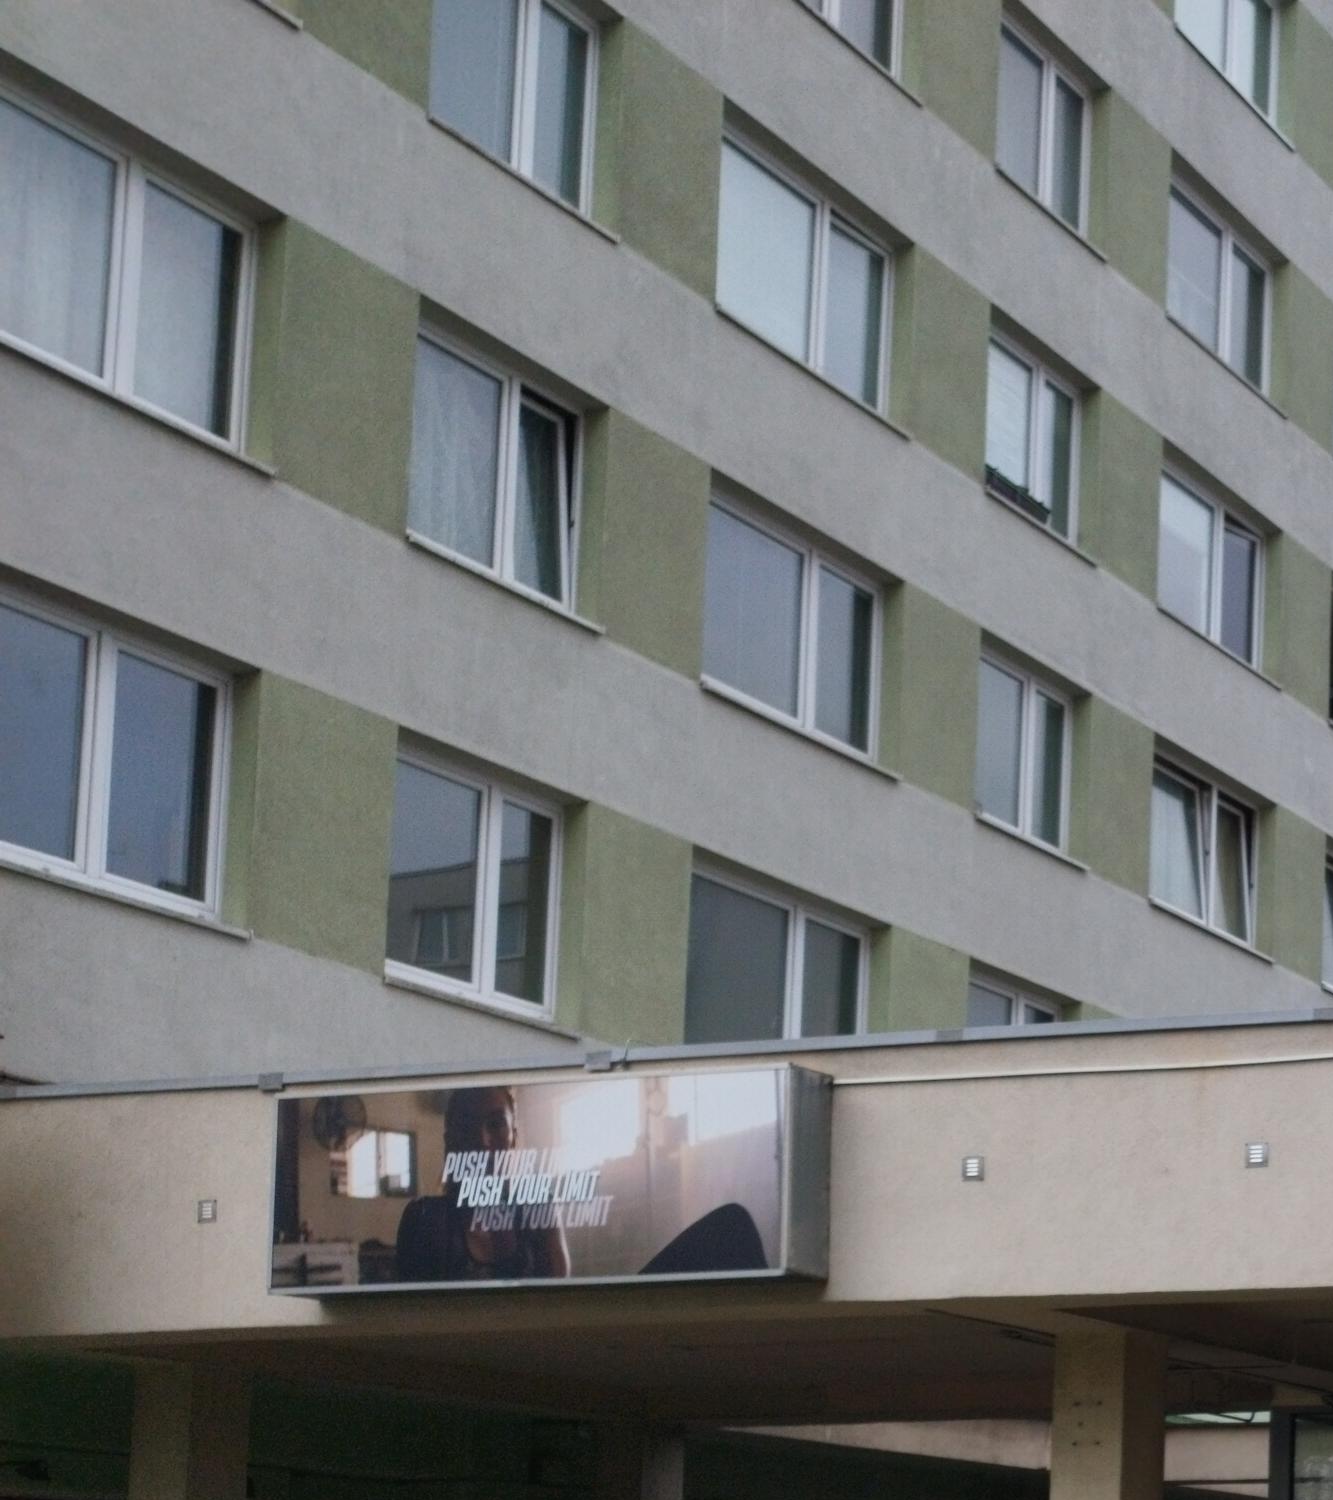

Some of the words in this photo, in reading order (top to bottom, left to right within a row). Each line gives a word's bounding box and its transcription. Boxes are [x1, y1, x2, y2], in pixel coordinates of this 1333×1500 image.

[441, 1151, 490, 1184] PUSH
[493, 1149, 538, 1180] YOUR
[457, 1174, 505, 1208] PUSH
[508, 1173, 552, 1206] YOUR
[553, 1169, 601, 1203] LIMIT
[471, 1203, 517, 1232] PUSH
[521, 1202, 563, 1230] YOUR
[566, 1195, 614, 1228] LIMIT
